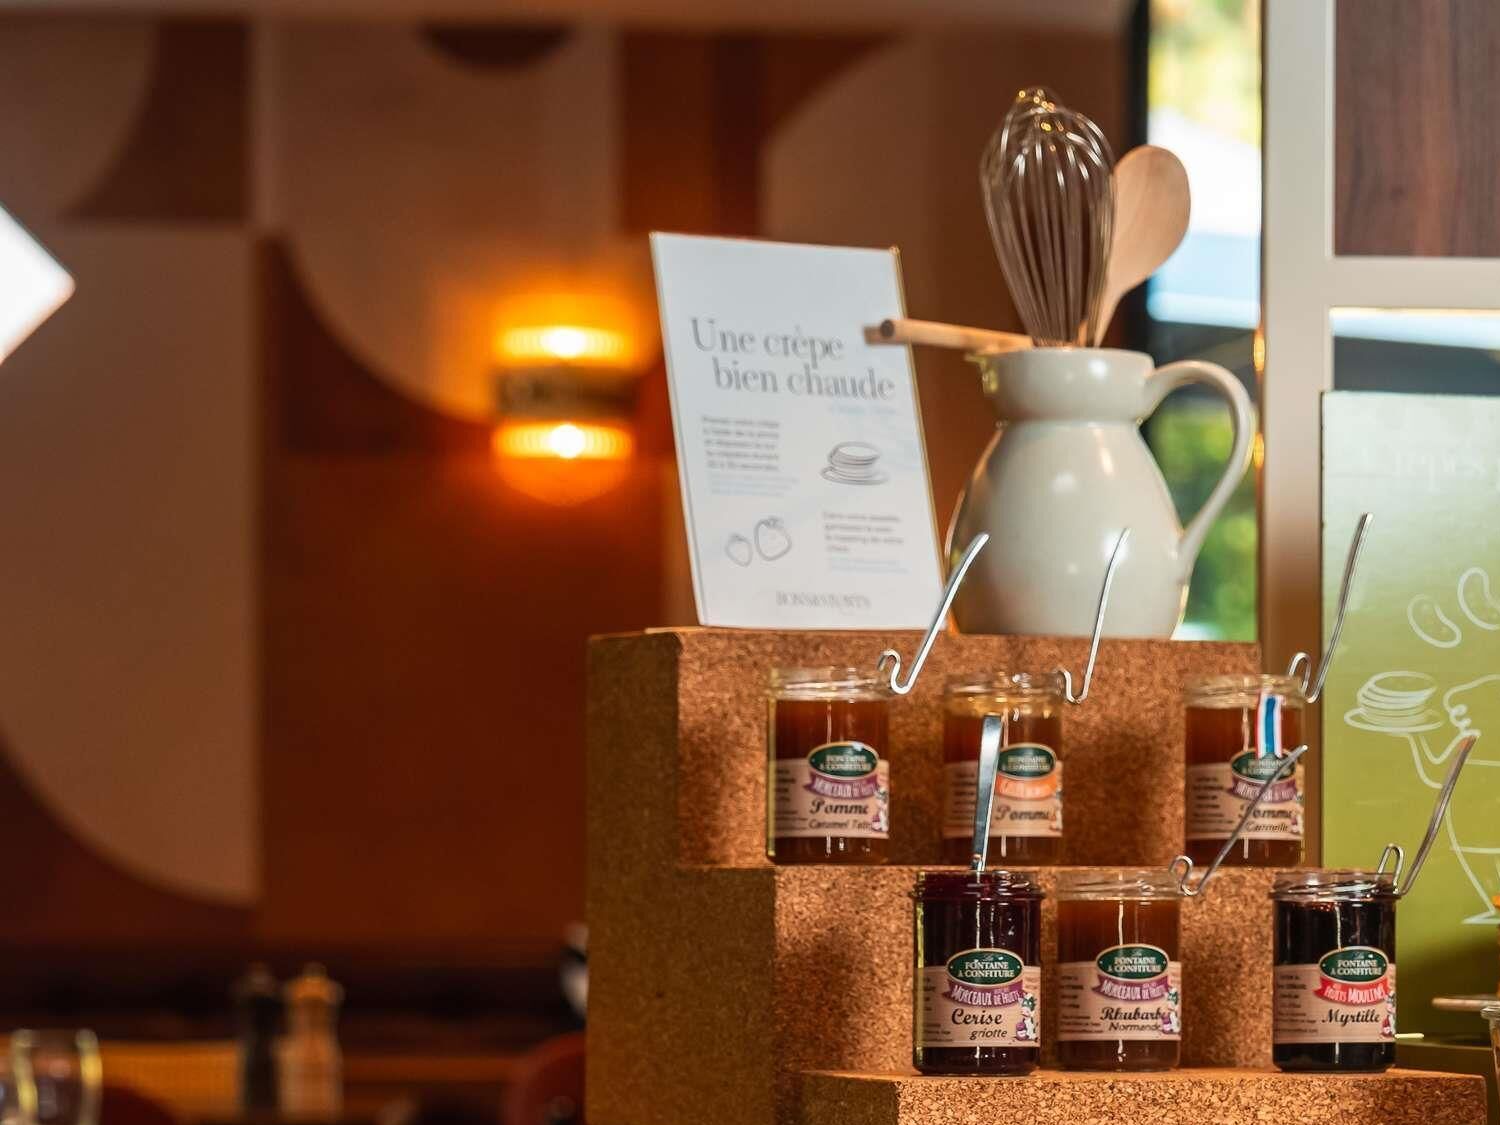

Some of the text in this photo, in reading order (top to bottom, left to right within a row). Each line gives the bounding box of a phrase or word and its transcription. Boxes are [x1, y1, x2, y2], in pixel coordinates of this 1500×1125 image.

[691, 317, 844, 370] Une crêpe
[712, 356, 896, 401] bien chaude
[809, 798, 869, 815] Pomme
[965, 961, 1009, 970] FONTAINE
[1337, 959, 1378, 968] FONTAINE
[965, 969, 1015, 978] CONFITURE
[951, 1007, 1003, 1025] Cerise
[1321, 1008, 1381, 1028] Myrtille
[969, 1028, 1008, 1041] griotte
